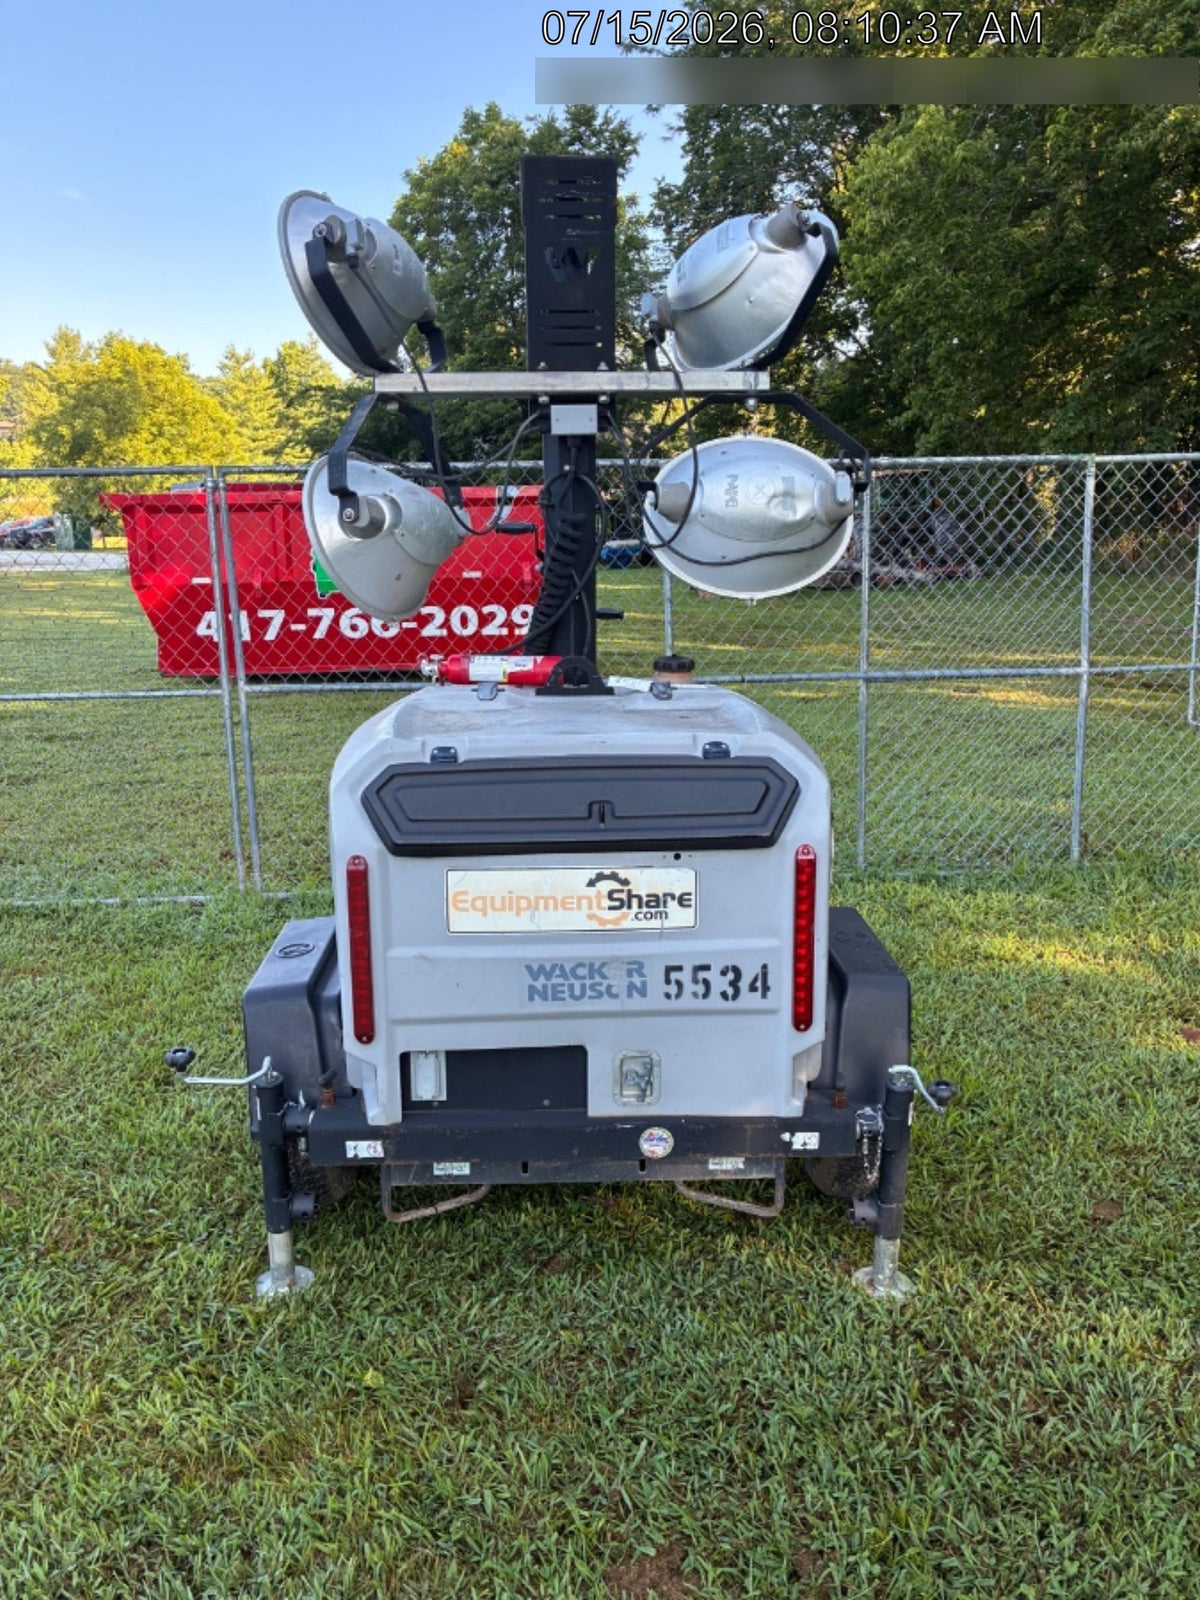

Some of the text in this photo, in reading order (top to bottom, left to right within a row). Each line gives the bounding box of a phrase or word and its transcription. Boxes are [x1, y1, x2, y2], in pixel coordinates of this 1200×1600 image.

[451, 888, 693, 917] EquipmentShare
[524, 960, 648, 982] WACKR
[663, 963, 771, 1001] 5534
